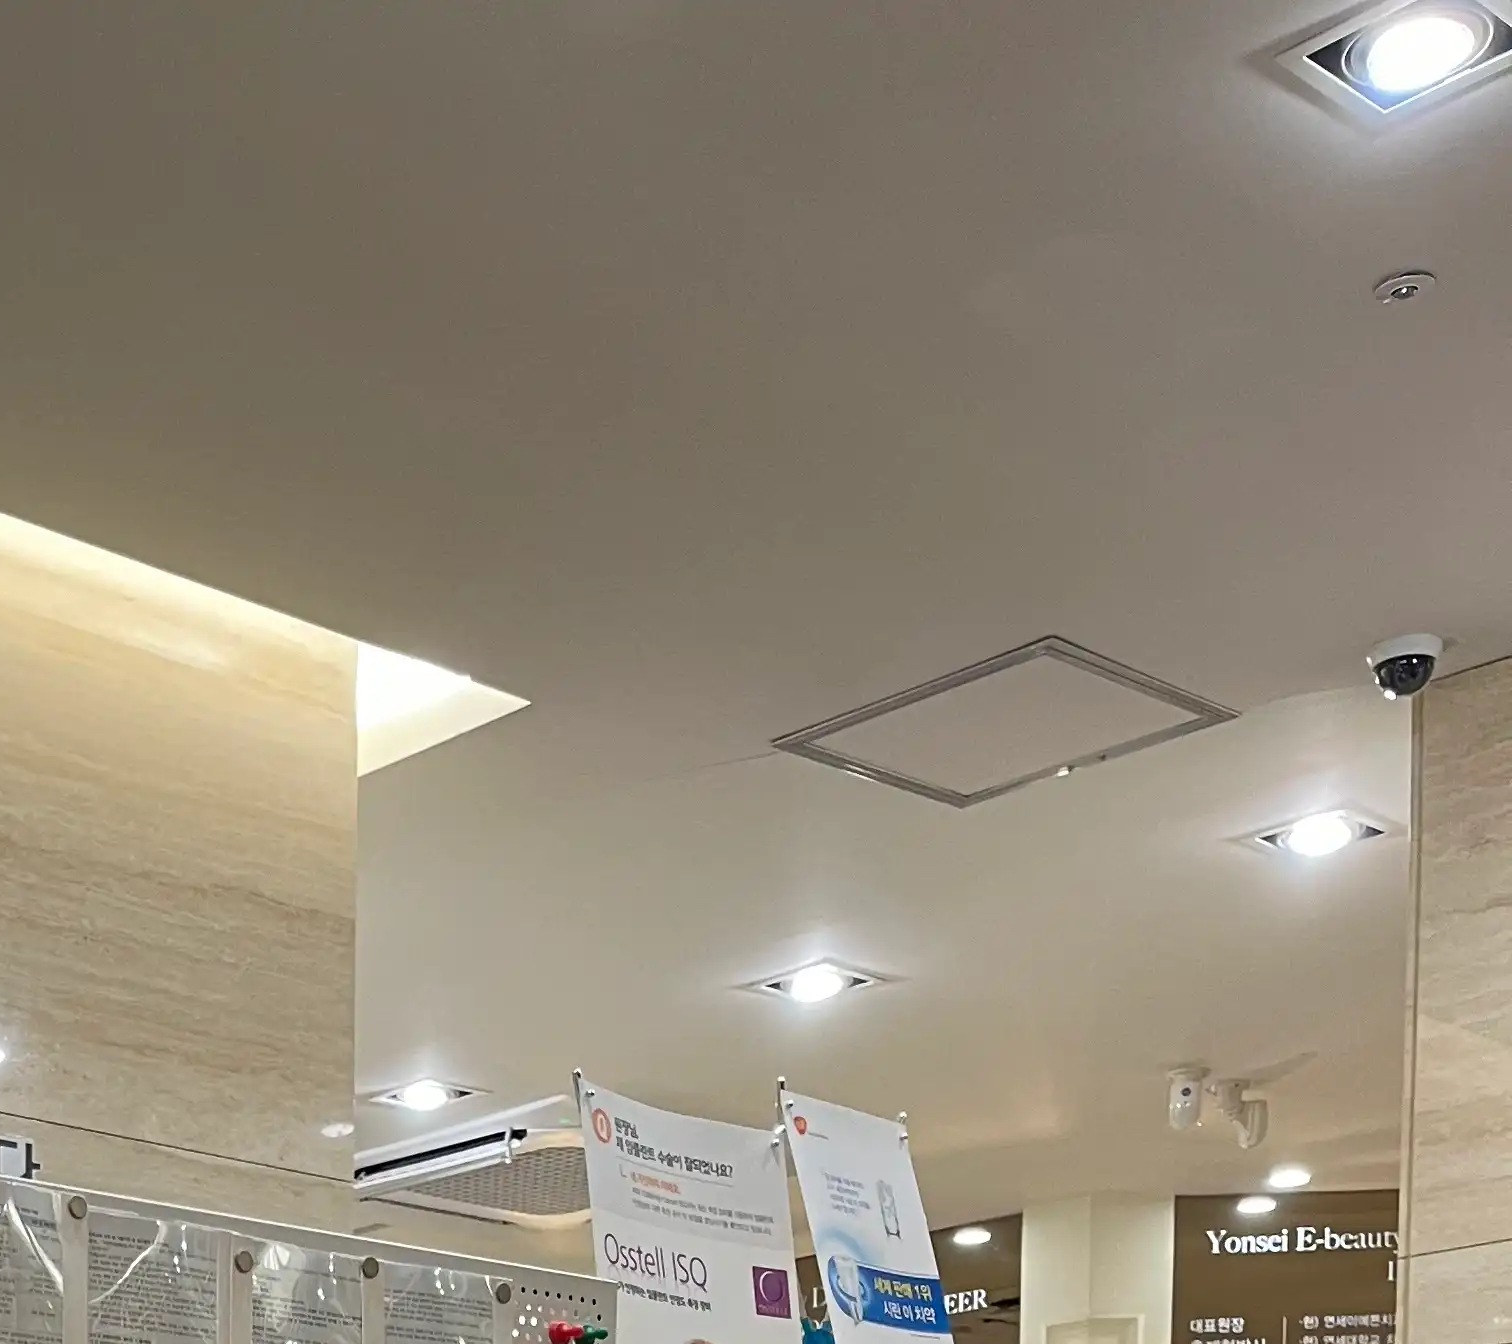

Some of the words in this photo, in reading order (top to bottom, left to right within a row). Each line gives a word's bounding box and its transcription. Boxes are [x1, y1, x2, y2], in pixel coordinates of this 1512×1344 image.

[1206, 1228, 1289, 1255] Yonsei
[604, 1233, 665, 1279] Osstell
[672, 1252, 707, 1293] ISQ
[914, 1284, 933, 1302] 1위
[884, 1301, 901, 1319] 시린
[903, 1305, 913, 1322] 이
[916, 1307, 936, 1325] 치약
[1189, 1316, 1245, 1334] 대표원장
